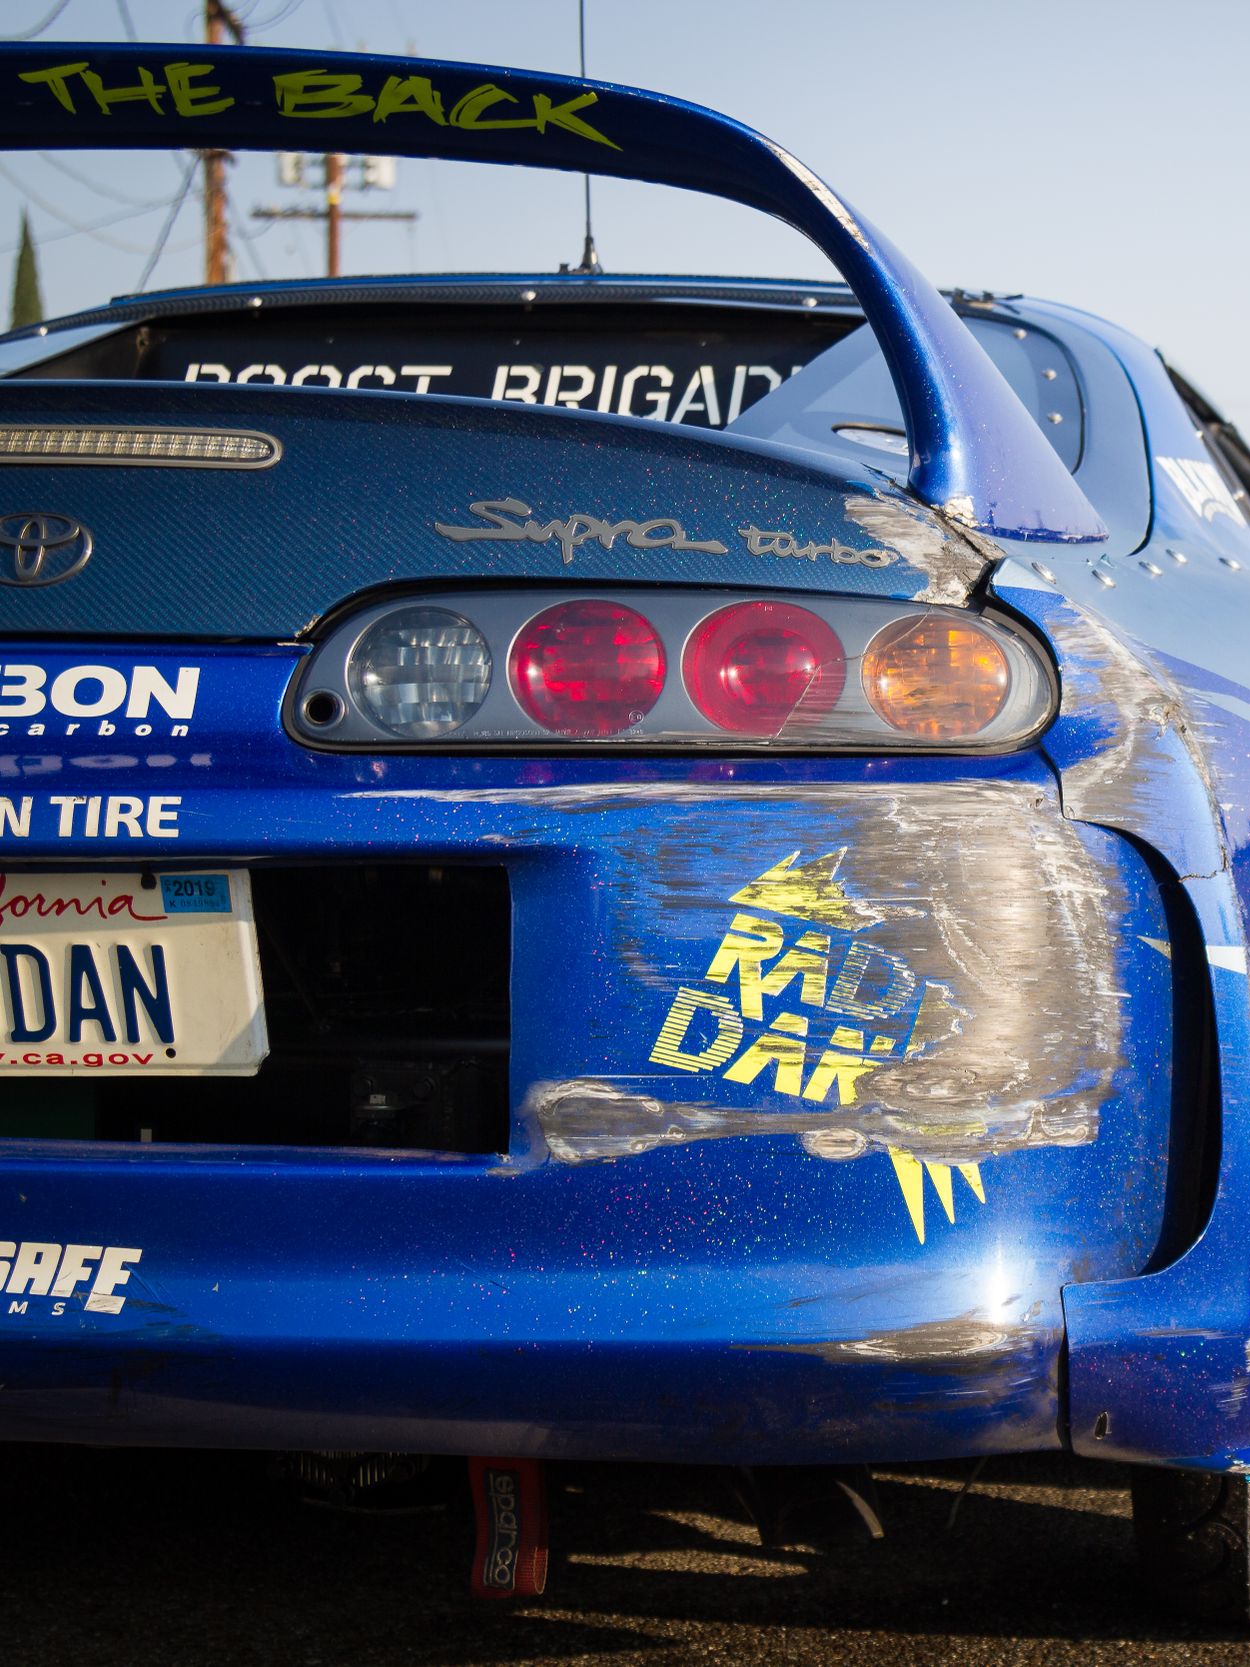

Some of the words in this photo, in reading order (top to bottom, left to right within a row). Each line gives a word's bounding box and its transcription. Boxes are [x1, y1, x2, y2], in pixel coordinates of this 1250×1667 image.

[18, 62, 235, 118] THE
[273, 69, 623, 151] BACK
[491, 365, 803, 425] BRIGAD
[435, 497, 727, 565] Supra
[737, 525, 899, 568] turbo
[50, 796, 182, 838] TIRE
[0, 944, 175, 1043] DAN
[705, 913, 916, 1021] RAD
[490, 1475, 518, 1585] sparco
